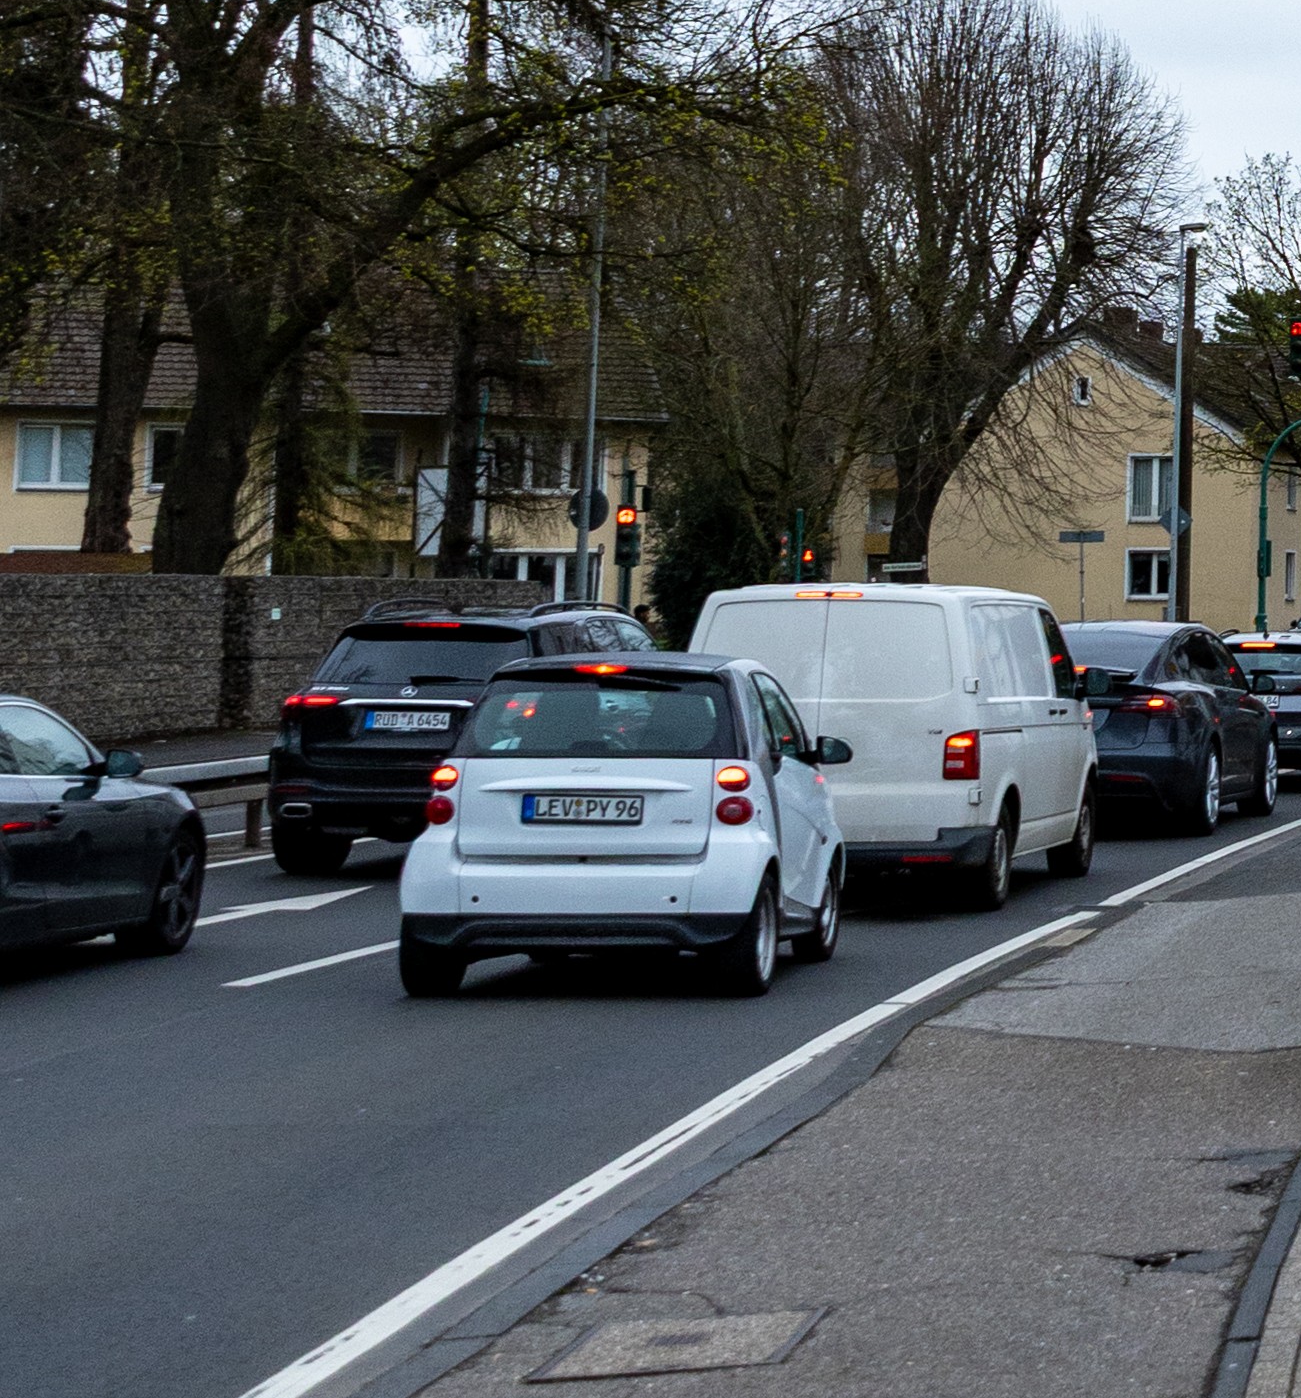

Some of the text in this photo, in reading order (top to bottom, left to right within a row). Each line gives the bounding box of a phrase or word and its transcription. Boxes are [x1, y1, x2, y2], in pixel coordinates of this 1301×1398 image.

[535, 798, 640, 818] LEV PY 96
